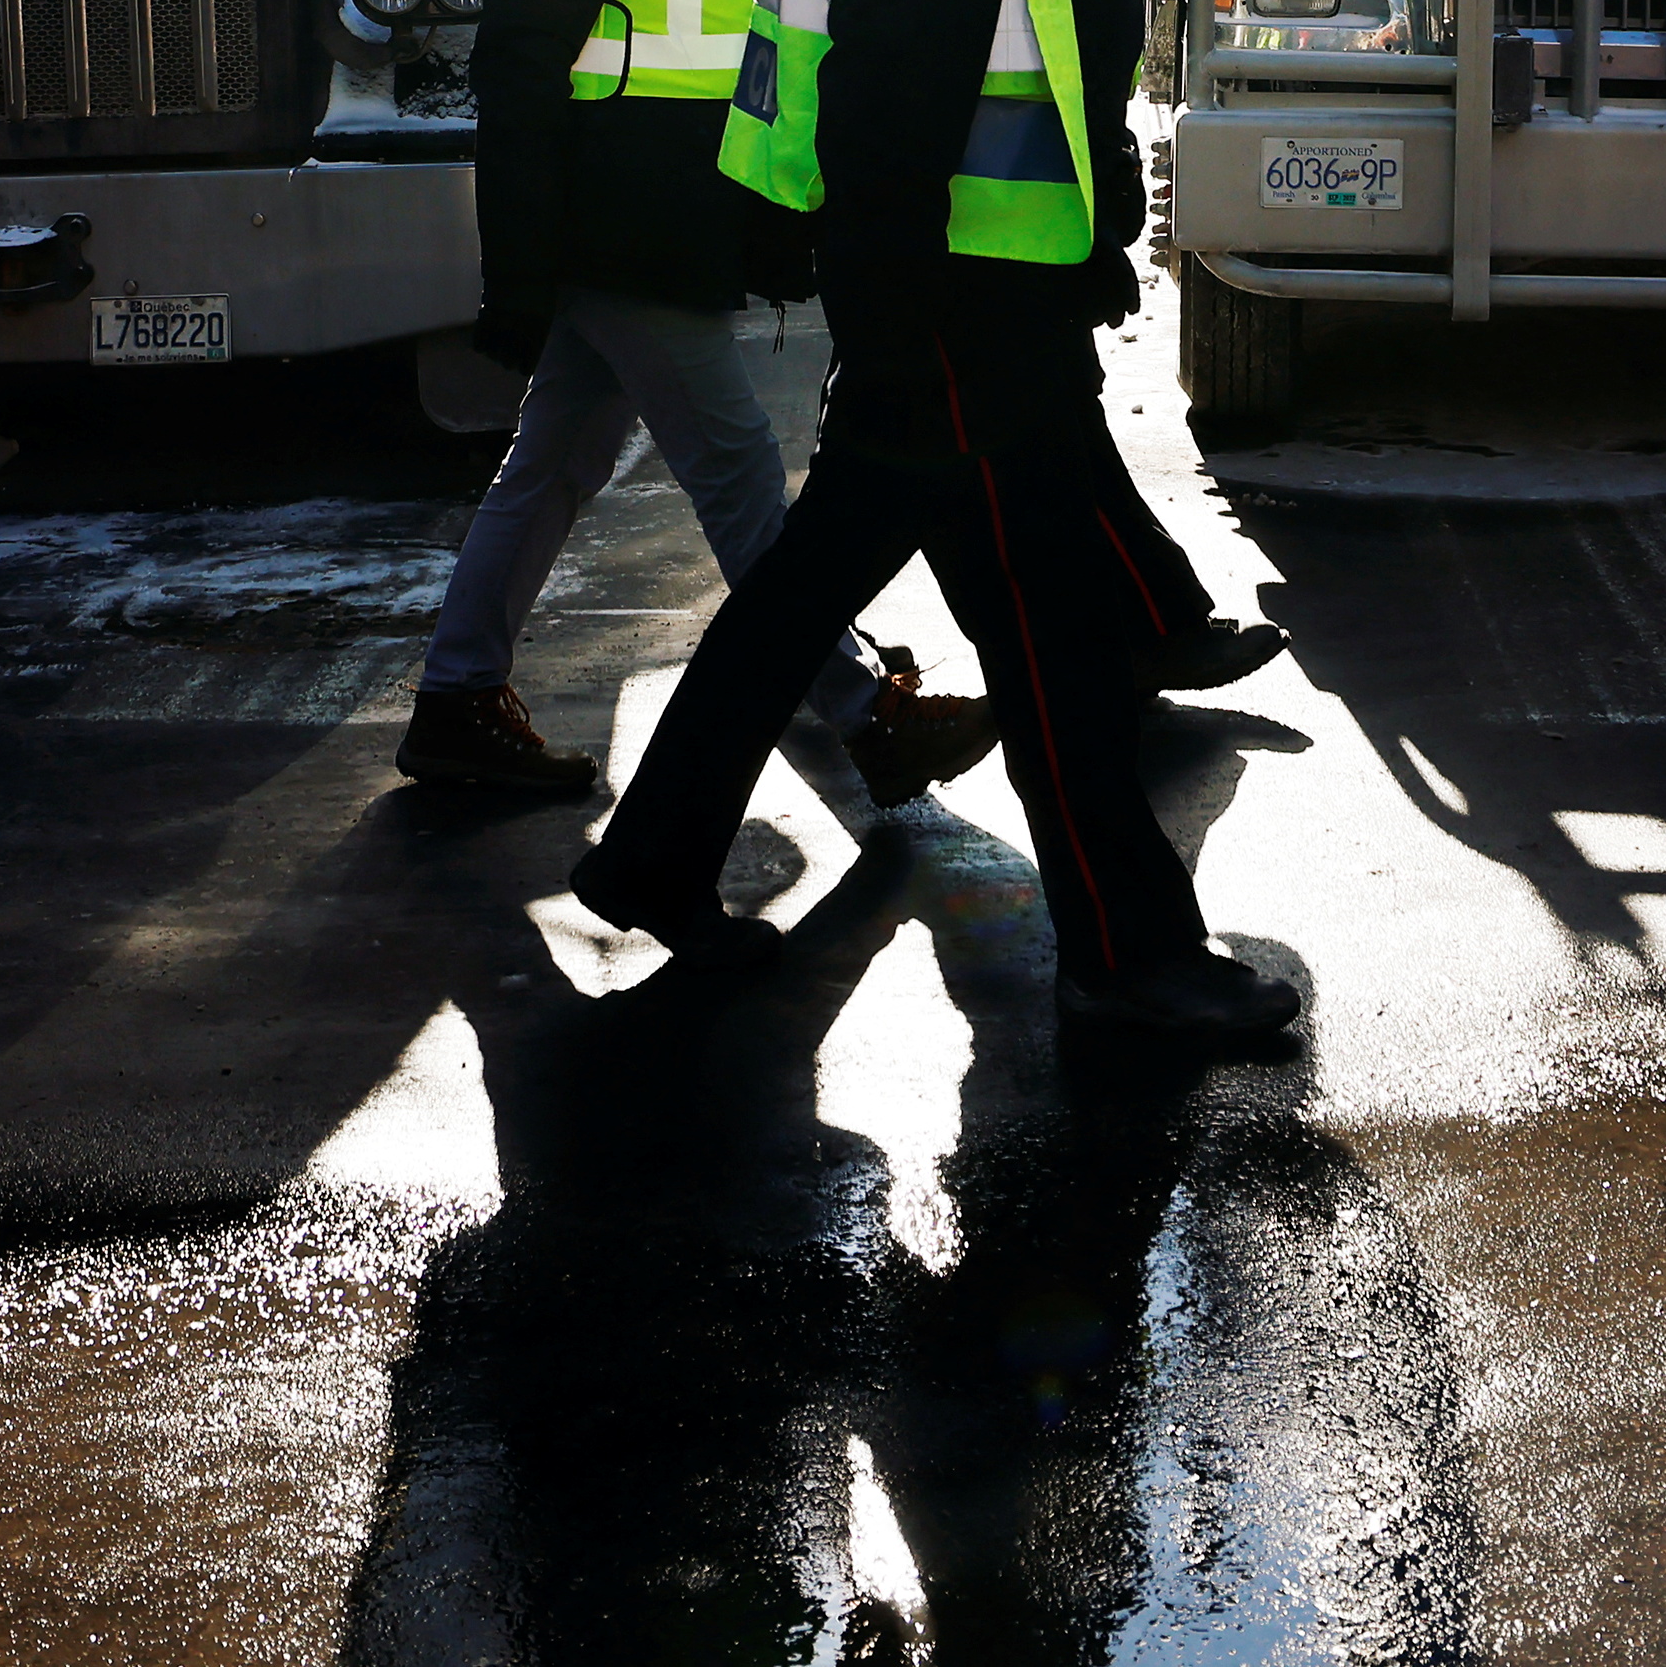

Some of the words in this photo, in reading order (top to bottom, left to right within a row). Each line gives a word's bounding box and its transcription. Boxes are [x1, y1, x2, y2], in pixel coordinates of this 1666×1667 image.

[1292, 147, 1373, 157] APPORTIONED
[1266, 157, 1341, 190] 6036
[1361, 159, 1397, 191] 9P
[144, 302, 191, 313] Québec
[96, 312, 224, 350] L768220
